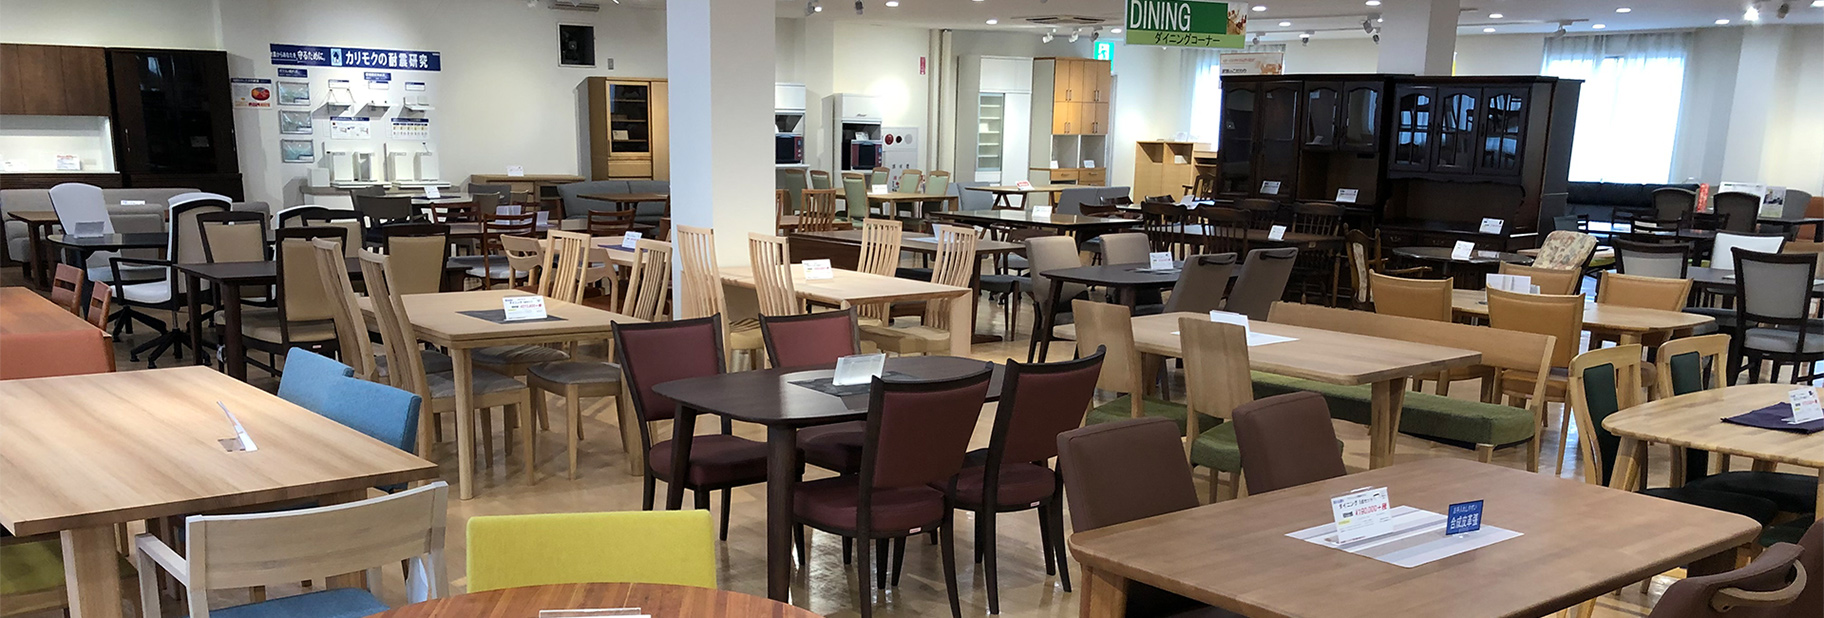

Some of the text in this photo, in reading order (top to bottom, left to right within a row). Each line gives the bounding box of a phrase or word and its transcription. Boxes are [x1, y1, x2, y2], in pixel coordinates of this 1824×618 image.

[1130, 0, 1191, 32] DINING
[1155, 31, 1221, 46] ダイニングコーナー
[345, 50, 429, 69] カリモクの耐震研究
